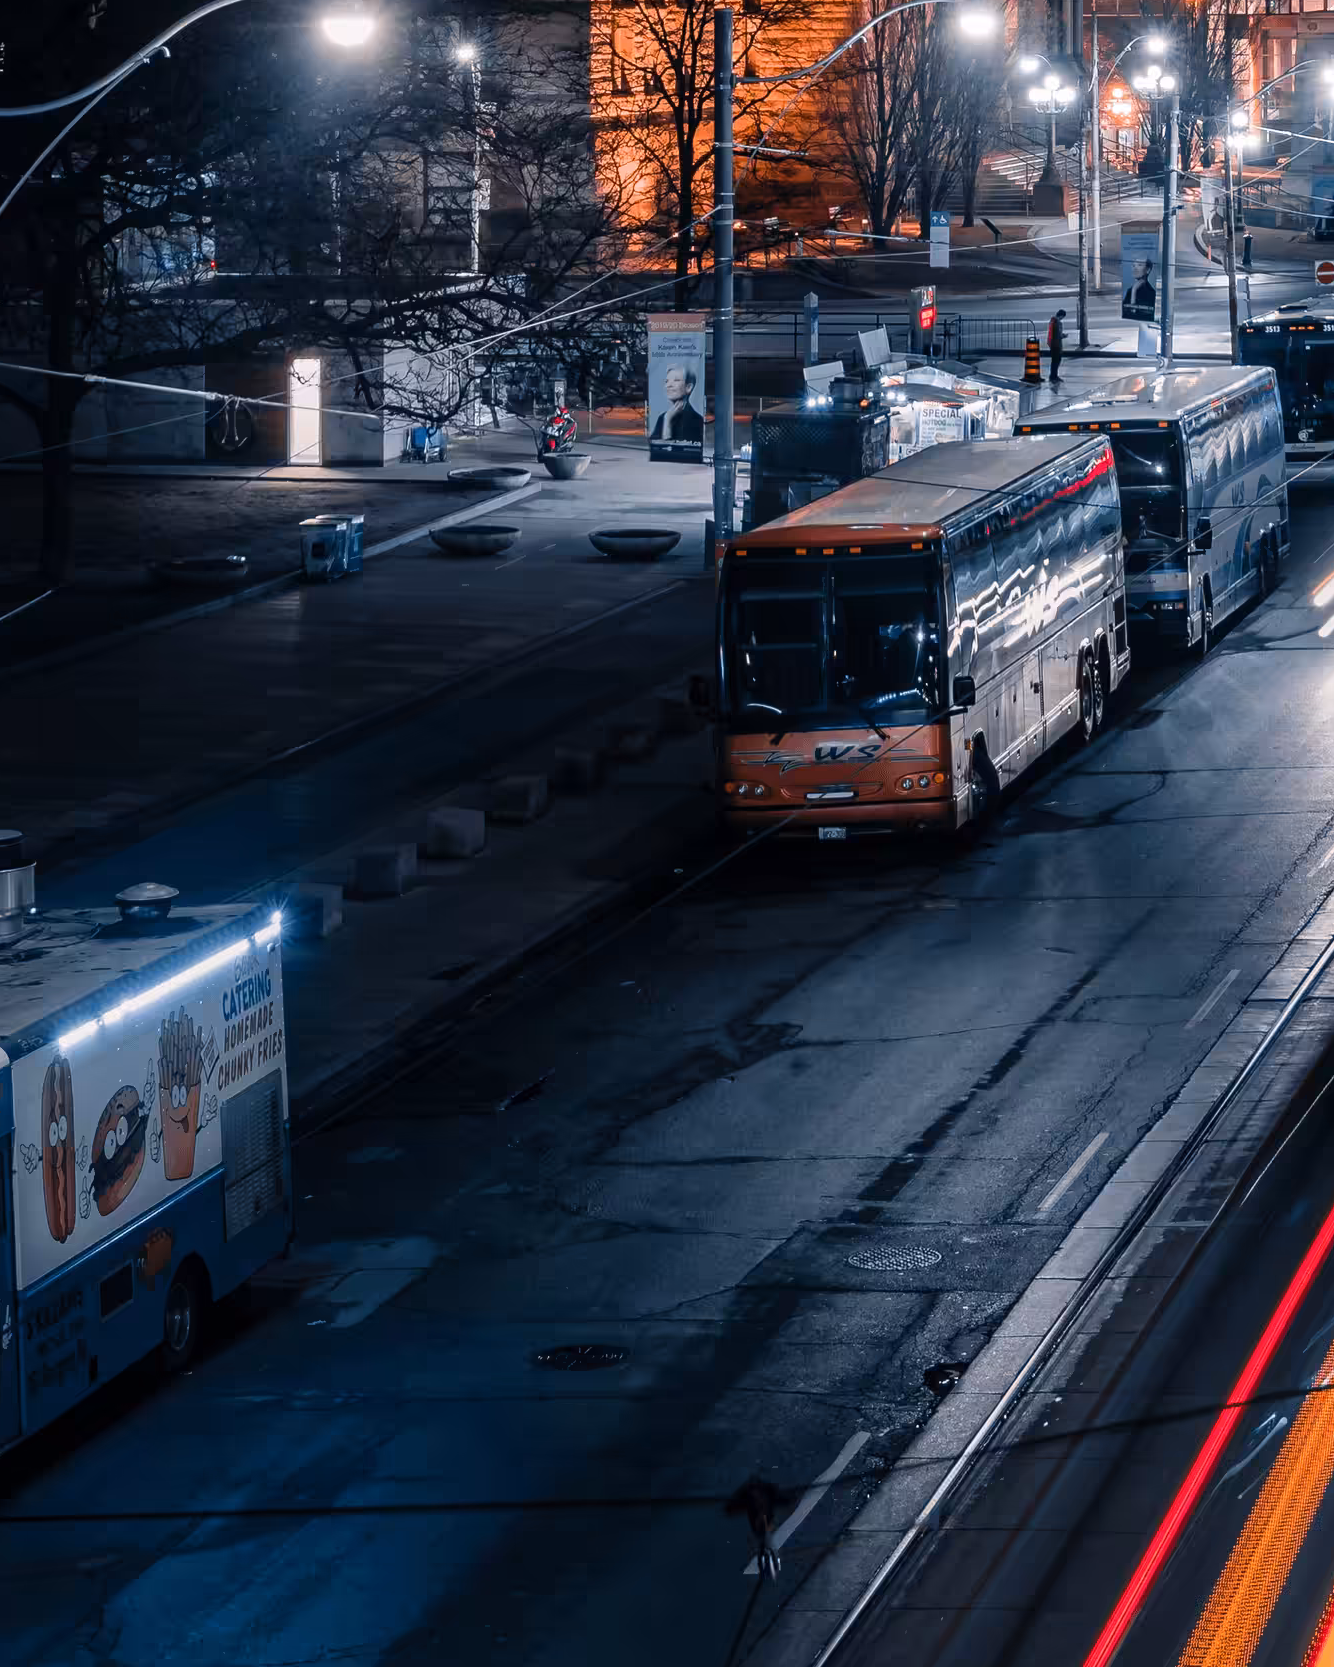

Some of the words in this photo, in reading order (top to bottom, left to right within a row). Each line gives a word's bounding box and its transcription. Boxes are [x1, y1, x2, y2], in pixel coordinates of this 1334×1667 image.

[923, 408, 962, 419] SPECIAL
[815, 744, 881, 760] WS
[222, 969, 271, 1022] CATERING
[224, 1001, 273, 1053] HOMEMADE
[218, 1043, 255, 1091] CHUNKY
[258, 1029, 283, 1067] FRIES
